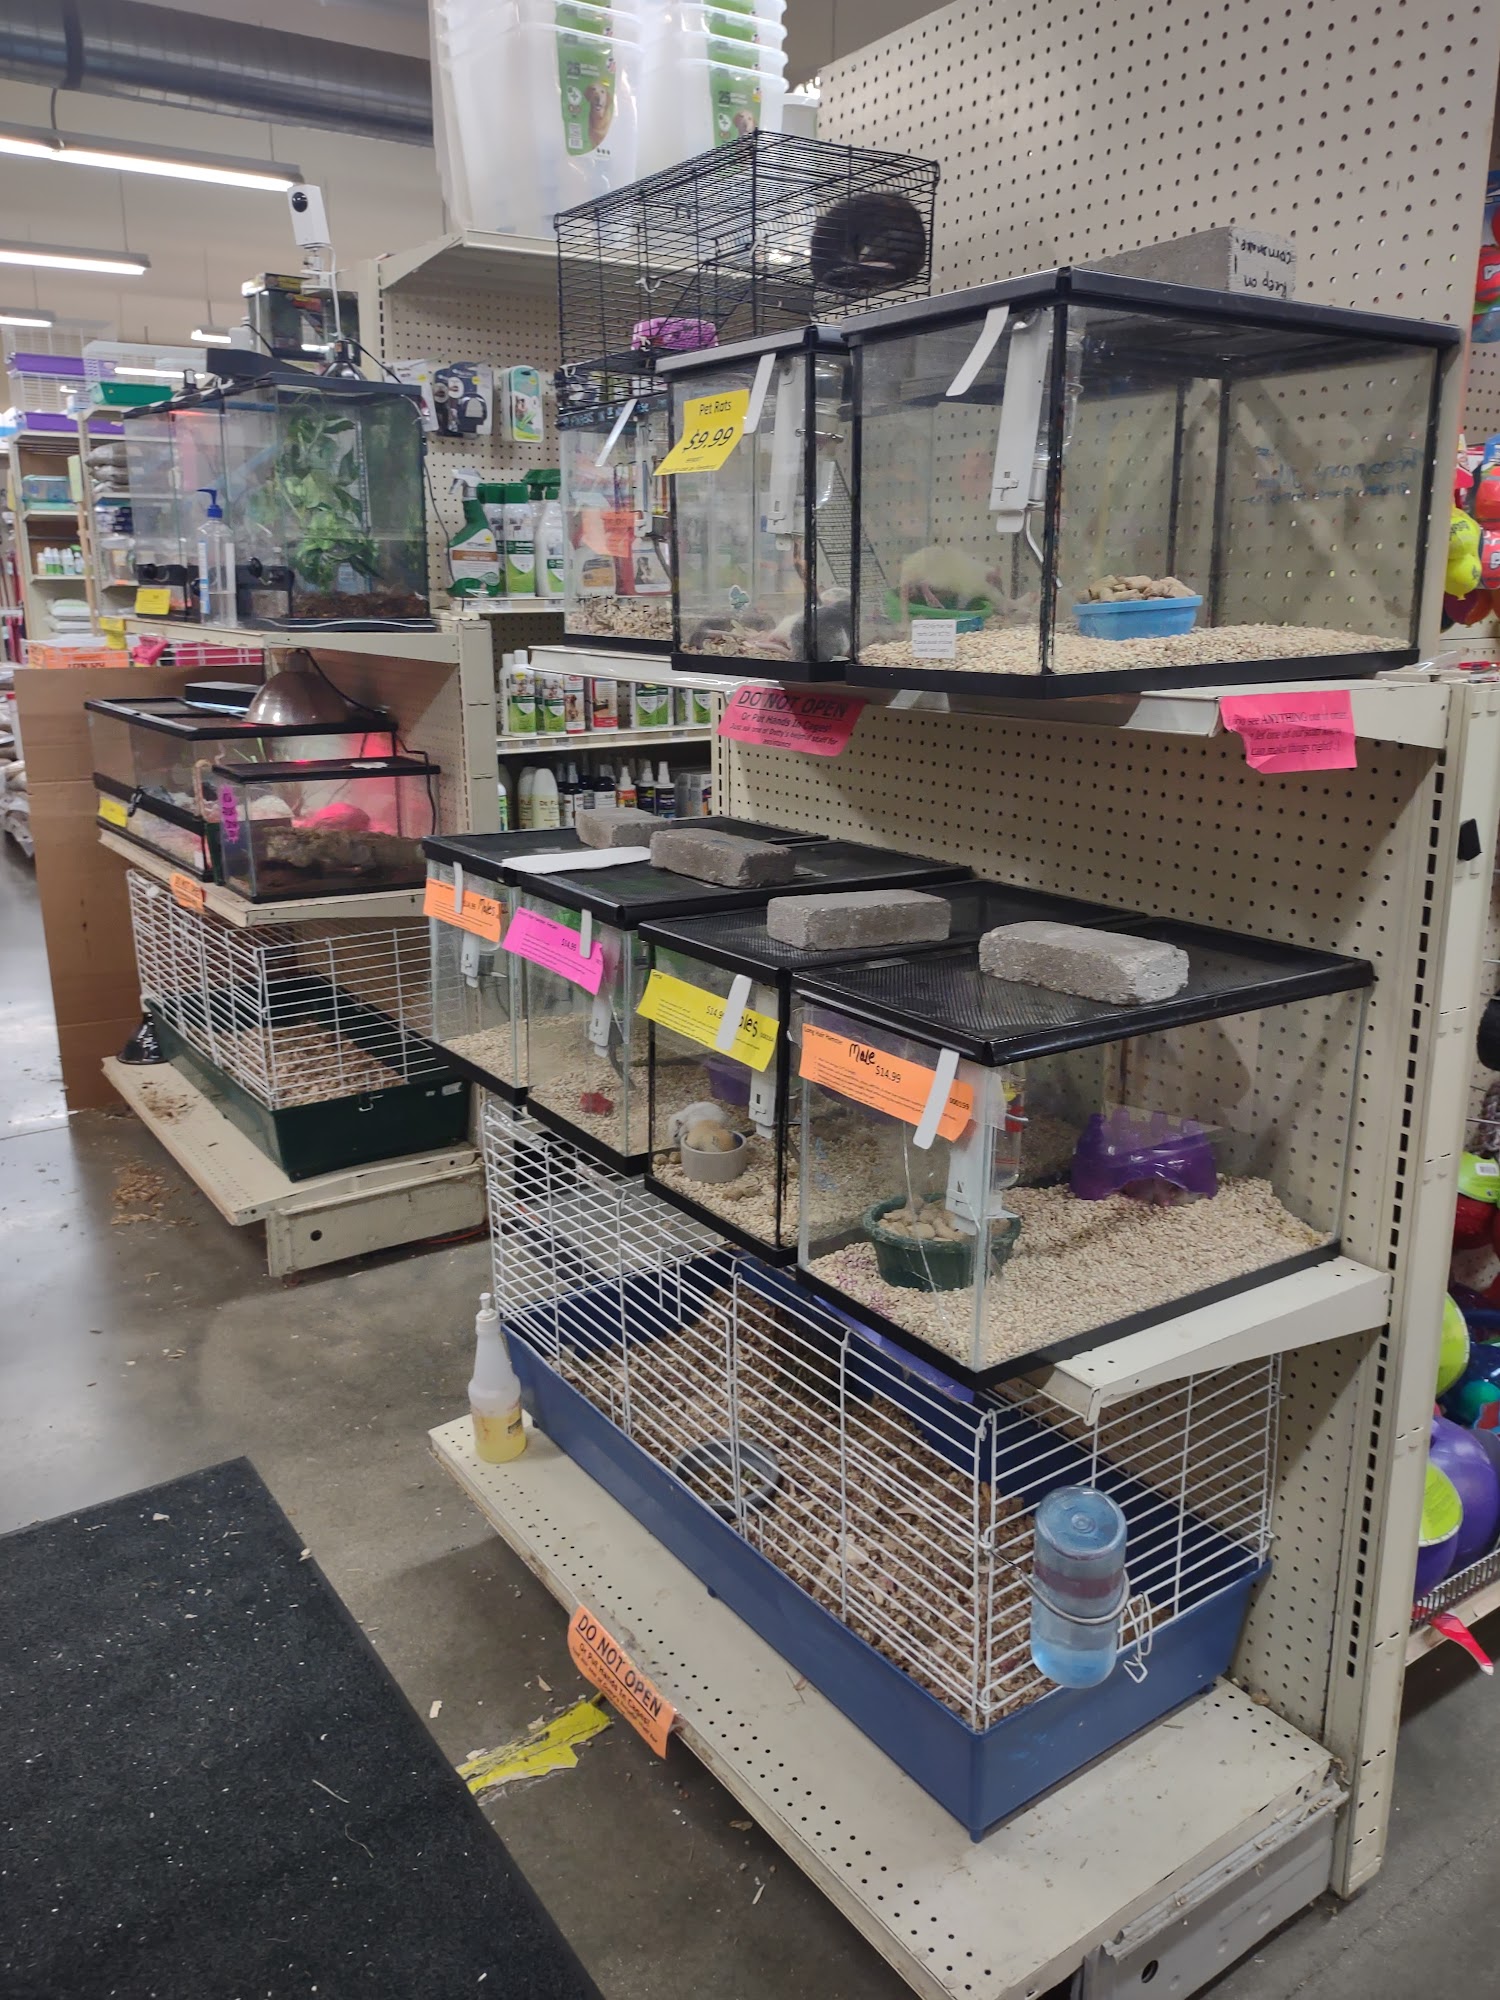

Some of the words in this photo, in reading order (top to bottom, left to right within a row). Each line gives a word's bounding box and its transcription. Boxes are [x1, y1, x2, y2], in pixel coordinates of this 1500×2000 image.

[699, 403, 713, 415] Pet
[714, 401, 732, 414] Rats
[682, 426, 734, 453] $9.99
[737, 690, 762, 707] DO
[764, 692, 798, 712] NOT
[801, 699, 849, 719] OPEN
[1262, 711, 1308, 726] ANYTHING
[848, 1042, 877, 1066] Male
[875, 1065, 902, 1084] $14.99
[578, 1614, 597, 1641] DO
[597, 1637, 626, 1673] NOT
[624, 1669, 663, 1717] OPEN
